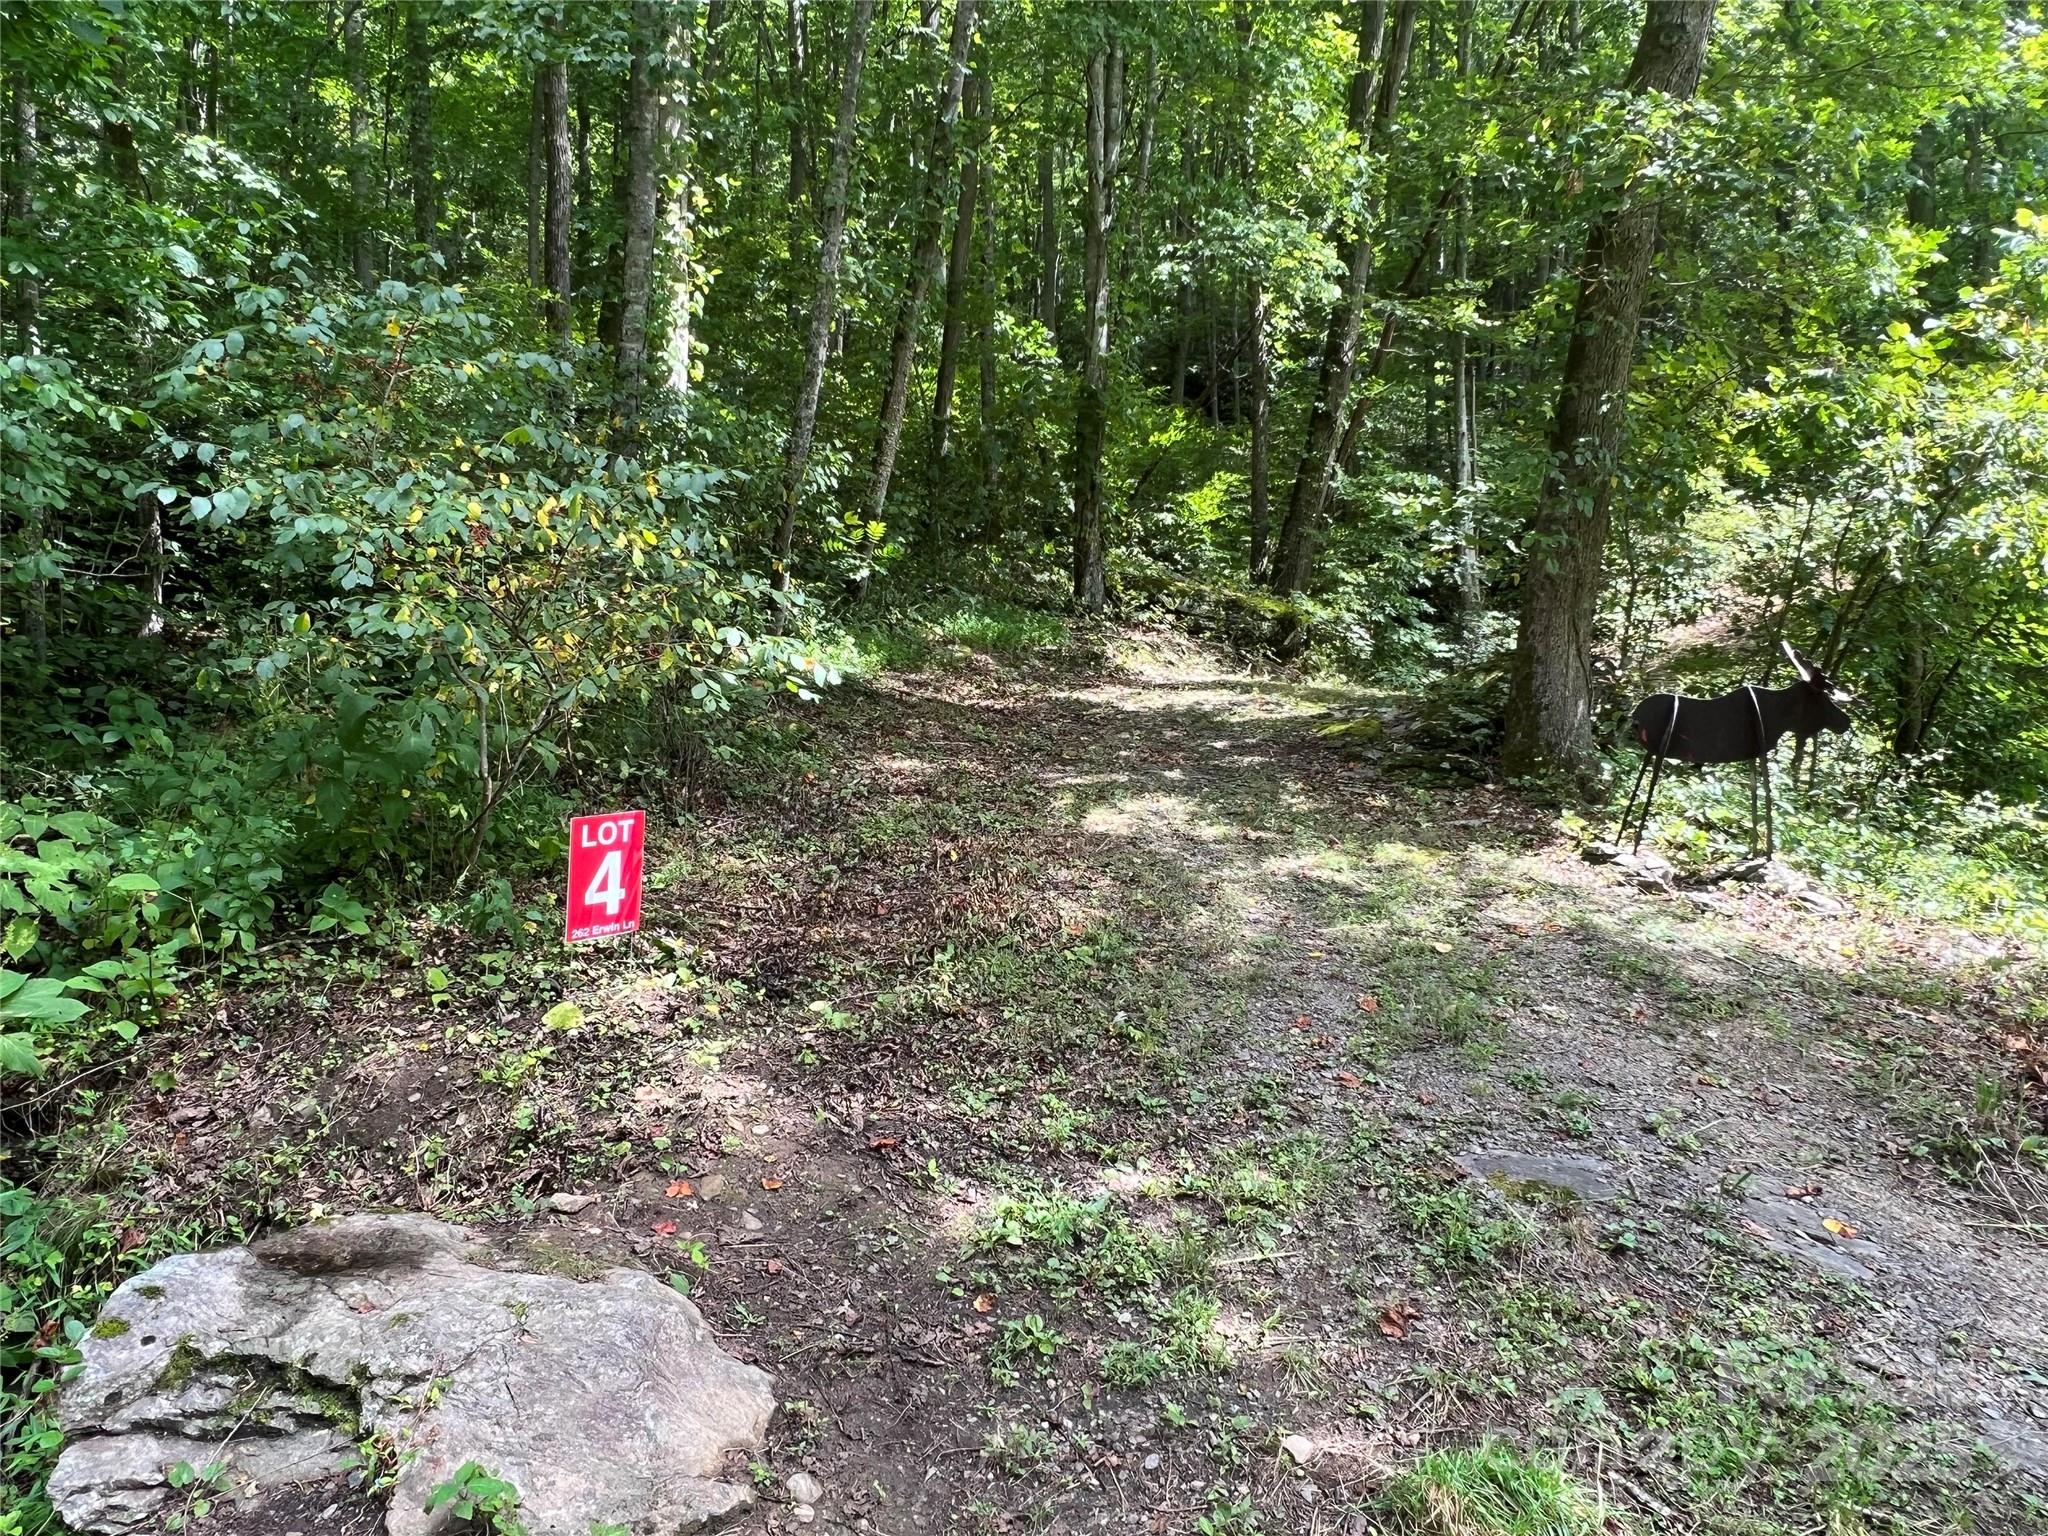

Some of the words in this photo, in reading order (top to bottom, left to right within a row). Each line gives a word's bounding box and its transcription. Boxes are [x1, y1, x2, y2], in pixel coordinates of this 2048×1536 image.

[581, 819, 635, 848] LOT
[584, 850, 626, 916] 4
[571, 927, 590, 939] 262
[592, 922, 620, 935] Erwin
[623, 920, 635, 930] Ln
